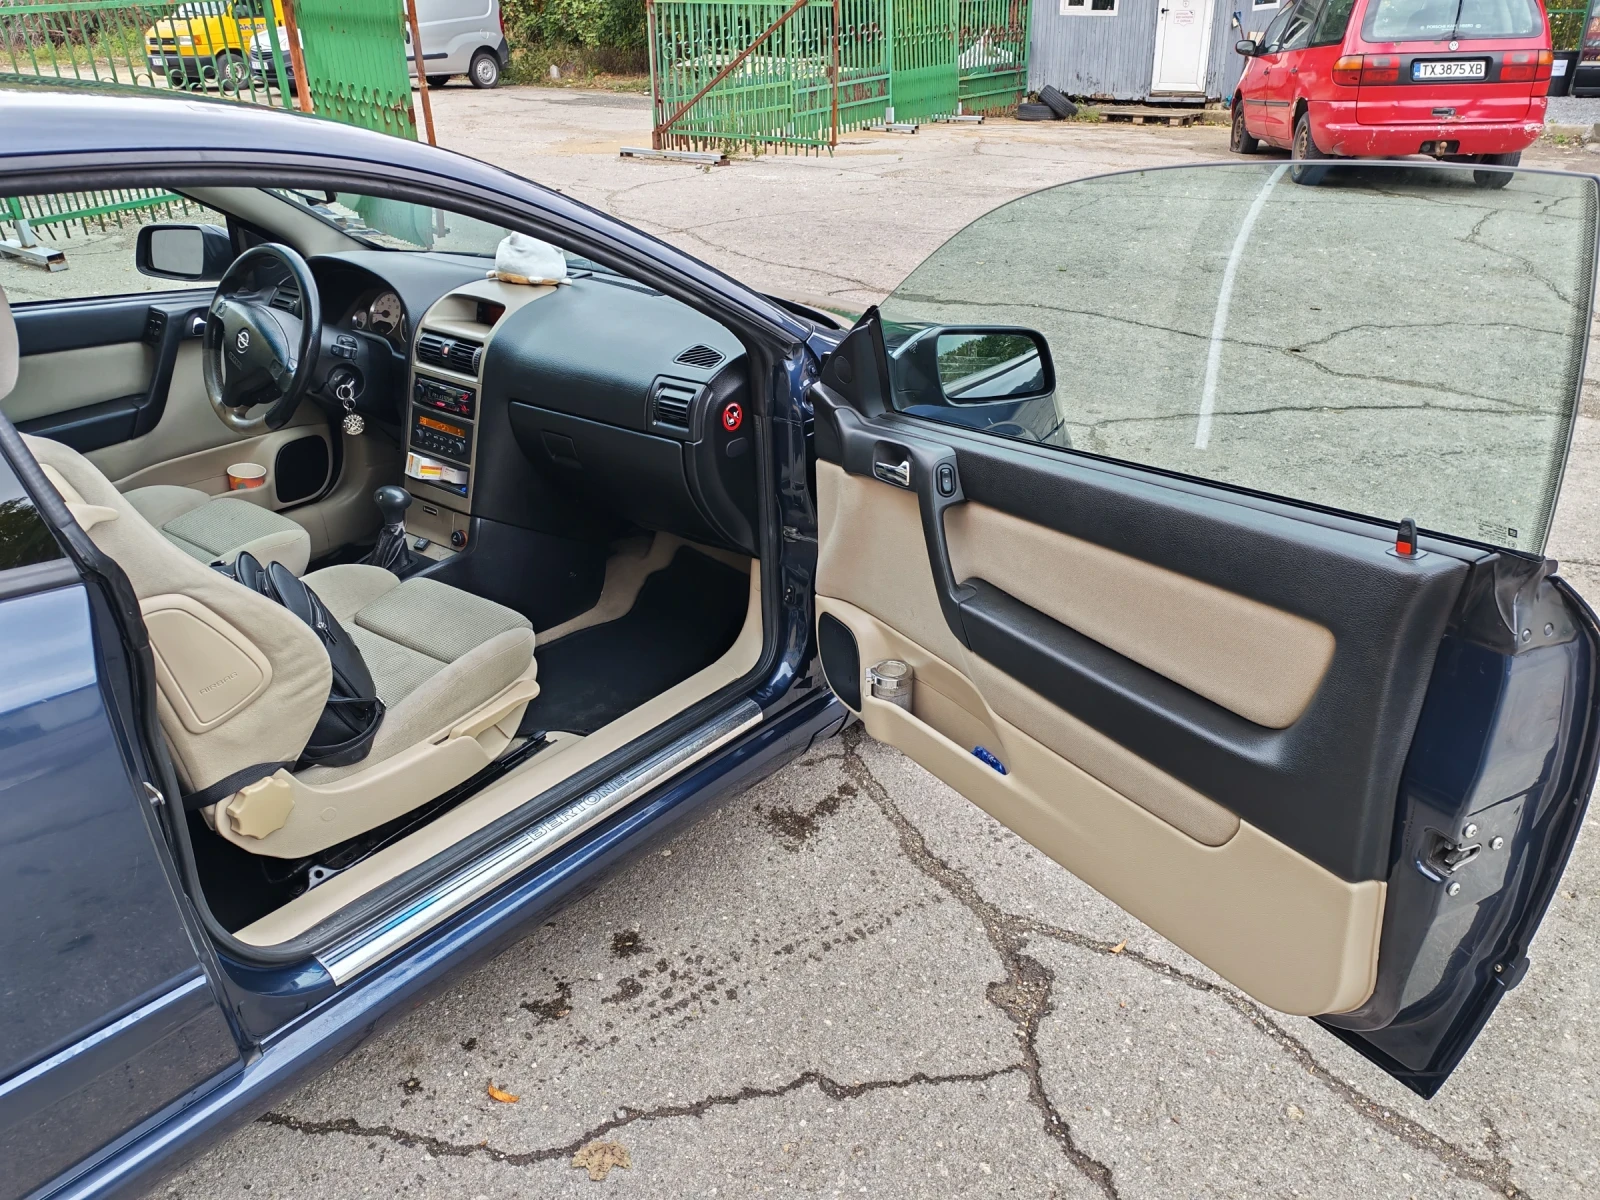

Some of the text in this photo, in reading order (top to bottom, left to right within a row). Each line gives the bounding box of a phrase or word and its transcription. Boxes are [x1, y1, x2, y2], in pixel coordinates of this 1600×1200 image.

[1422, 64, 1437, 76] TX
[1438, 63, 1466, 75] 3875
[1468, 63, 1483, 75] XB
[199, 671, 238, 695] AIRBAG
[526, 772, 629, 842] BERTONE
